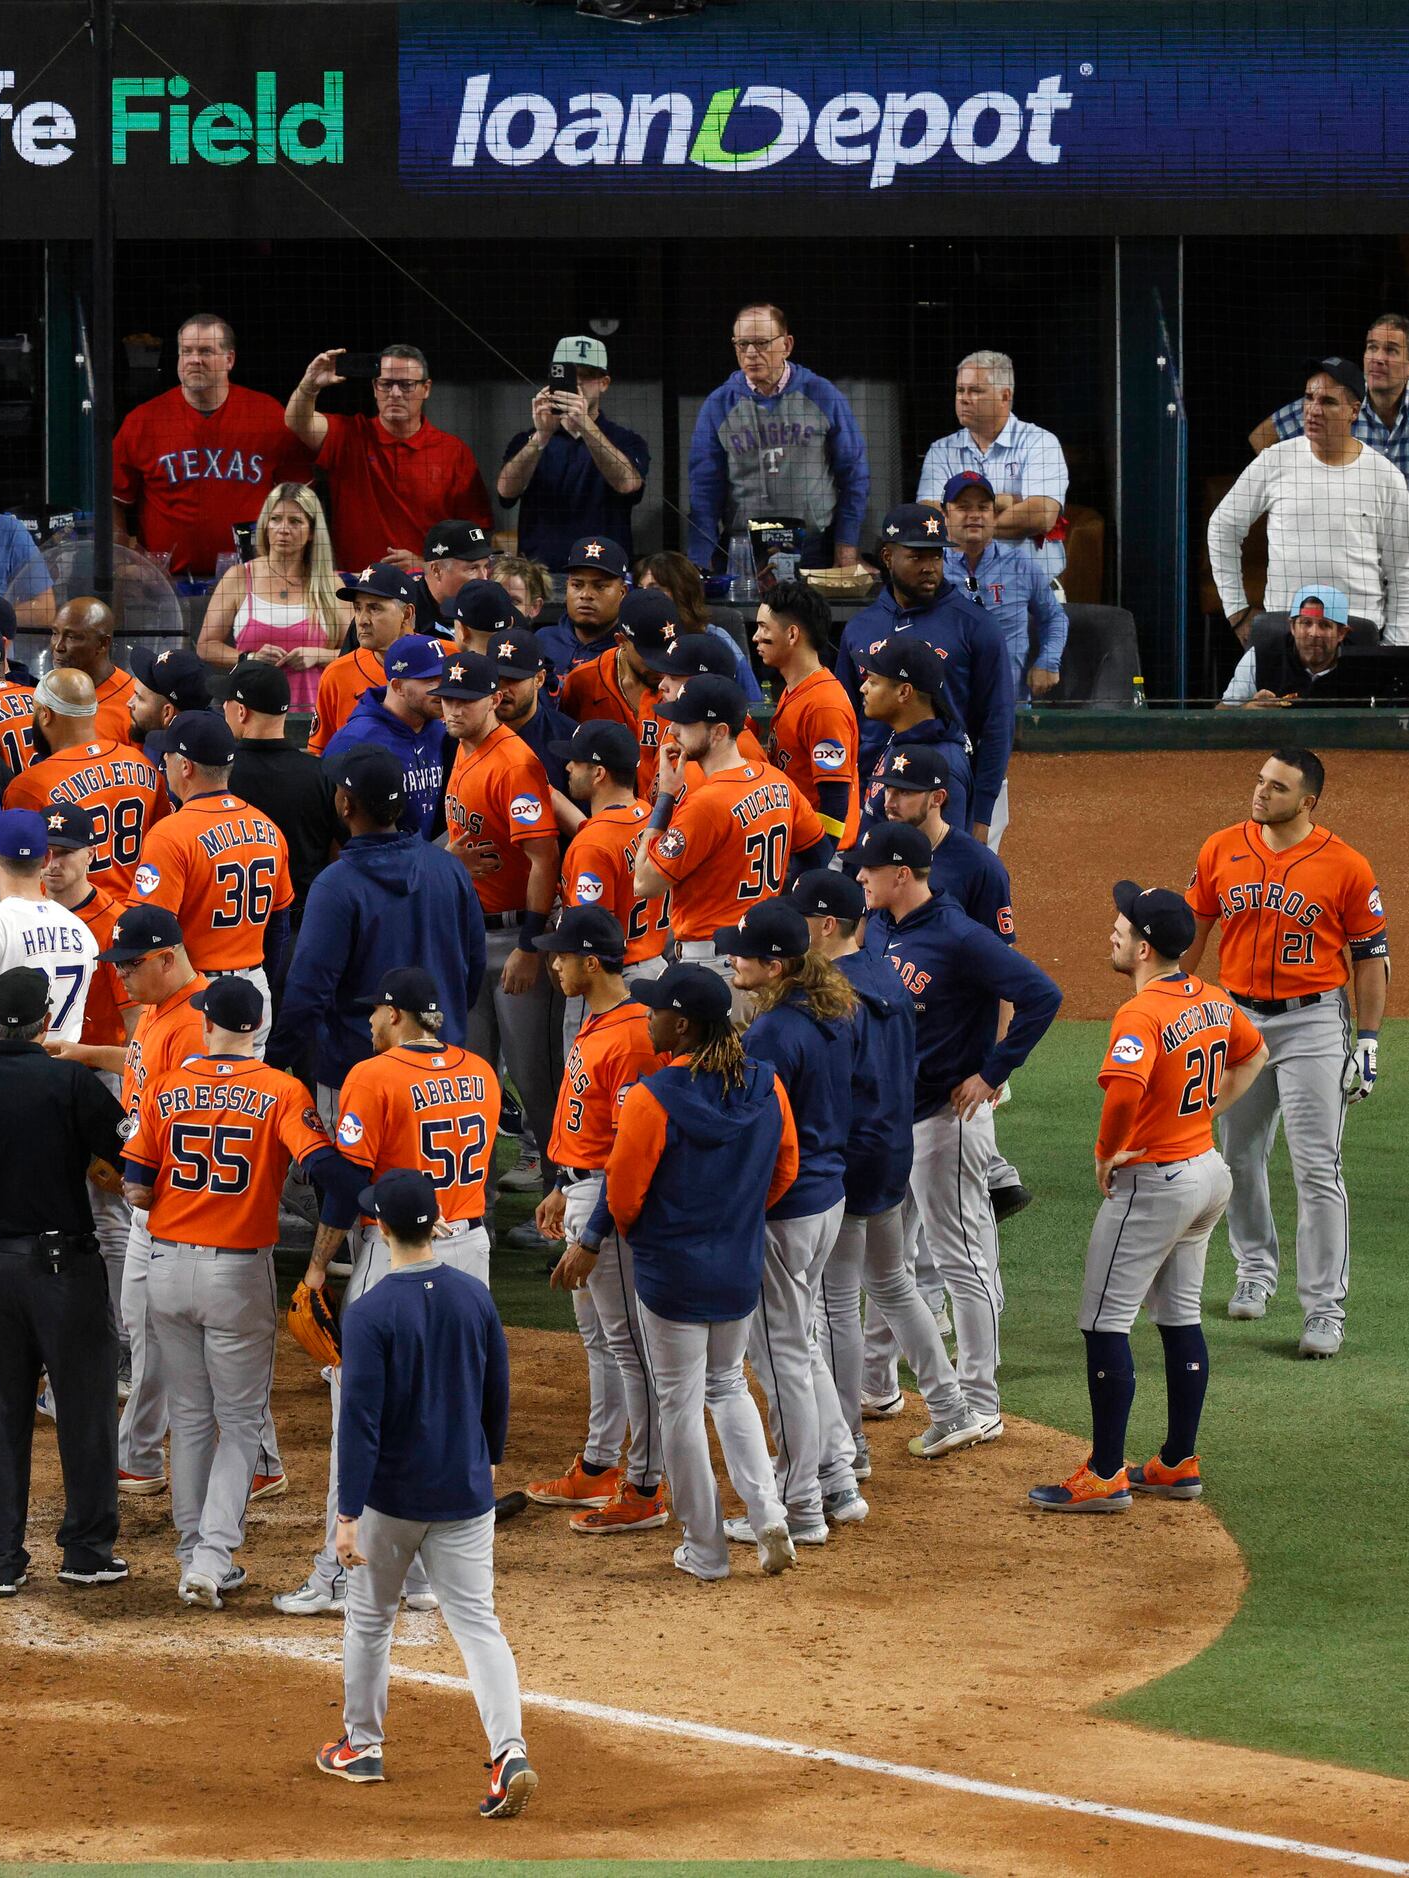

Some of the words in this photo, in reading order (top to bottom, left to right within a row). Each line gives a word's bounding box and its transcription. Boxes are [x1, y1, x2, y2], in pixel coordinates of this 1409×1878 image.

[111, 71, 344, 166] Field
[451, 74, 1073, 189] loanDepot
[576, 341, 591, 358] T
[730, 423, 815, 455] RANGERS
[159, 449, 264, 484] TEXAS
[762, 447, 784, 475] T
[1005, 462, 1017, 479] T
[988, 583, 1005, 604] T
[427, 639, 444, 658] T
[813, 750, 846, 760] OXY
[49, 760, 159, 805] SINGLETON
[511, 803, 541, 816] OXY
[731, 783, 790, 829] TUCKER
[84, 796, 145, 875] 28
[197, 818, 279, 859] MILLER
[135, 873, 159, 887] OXY
[737, 822, 789, 901] 30
[211, 855, 276, 929] 36
[1218, 881, 1324, 928] ASTROS
[22, 925, 85, 956] HAYES
[1281, 931, 1316, 965] 21
[31, 964, 87, 1032] 7
[1112, 1045, 1143, 1055] OXY
[410, 1075, 485, 1112] ABREU
[1178, 1038, 1228, 1117] 20
[157, 1084, 279, 1121] PRESSLY
[566, 1097, 584, 1134] 3
[170, 1122, 254, 1195] 55
[420, 1112, 488, 1191] 52
